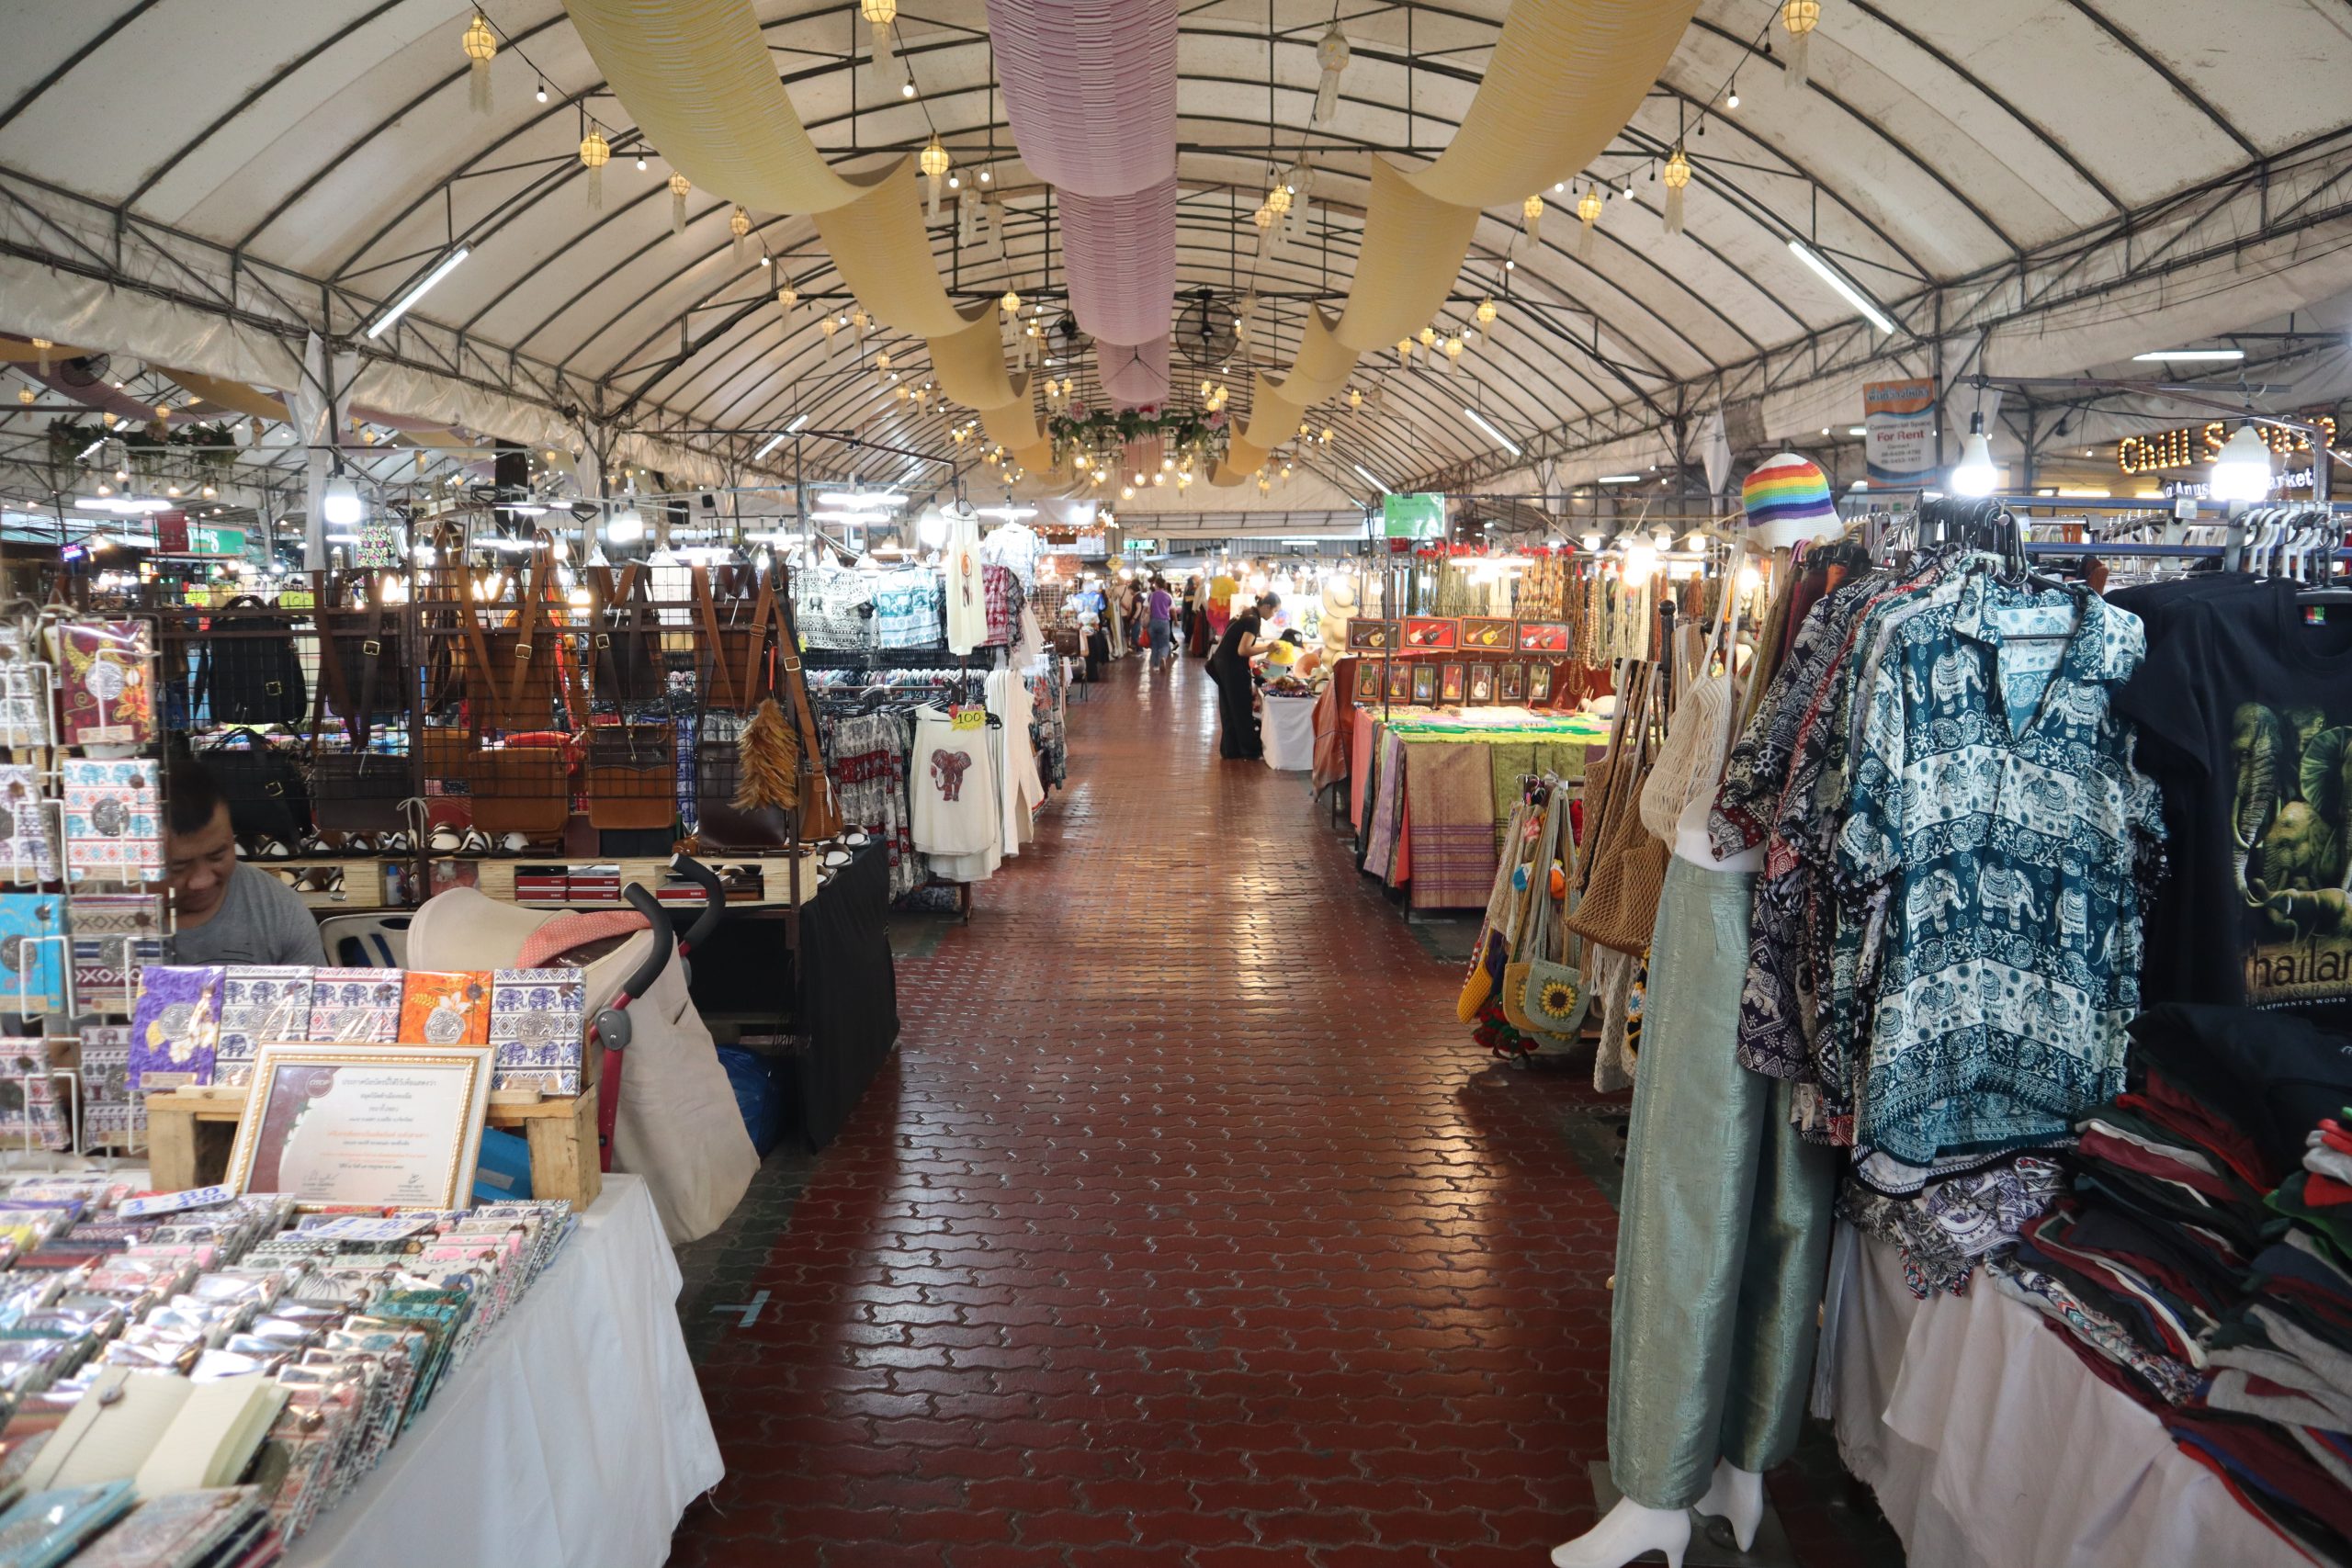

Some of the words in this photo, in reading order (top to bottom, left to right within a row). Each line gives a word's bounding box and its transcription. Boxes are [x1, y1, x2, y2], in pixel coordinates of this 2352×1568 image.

[1877, 432, 1894, 442] For
[1897, 430, 1926, 441] Rent
[2118, 428, 2192, 474] Chill
[2267, 467, 2314, 491] arket
[957, 712, 981, 724] 100
[2315, 997, 2346, 1005] WOOD
